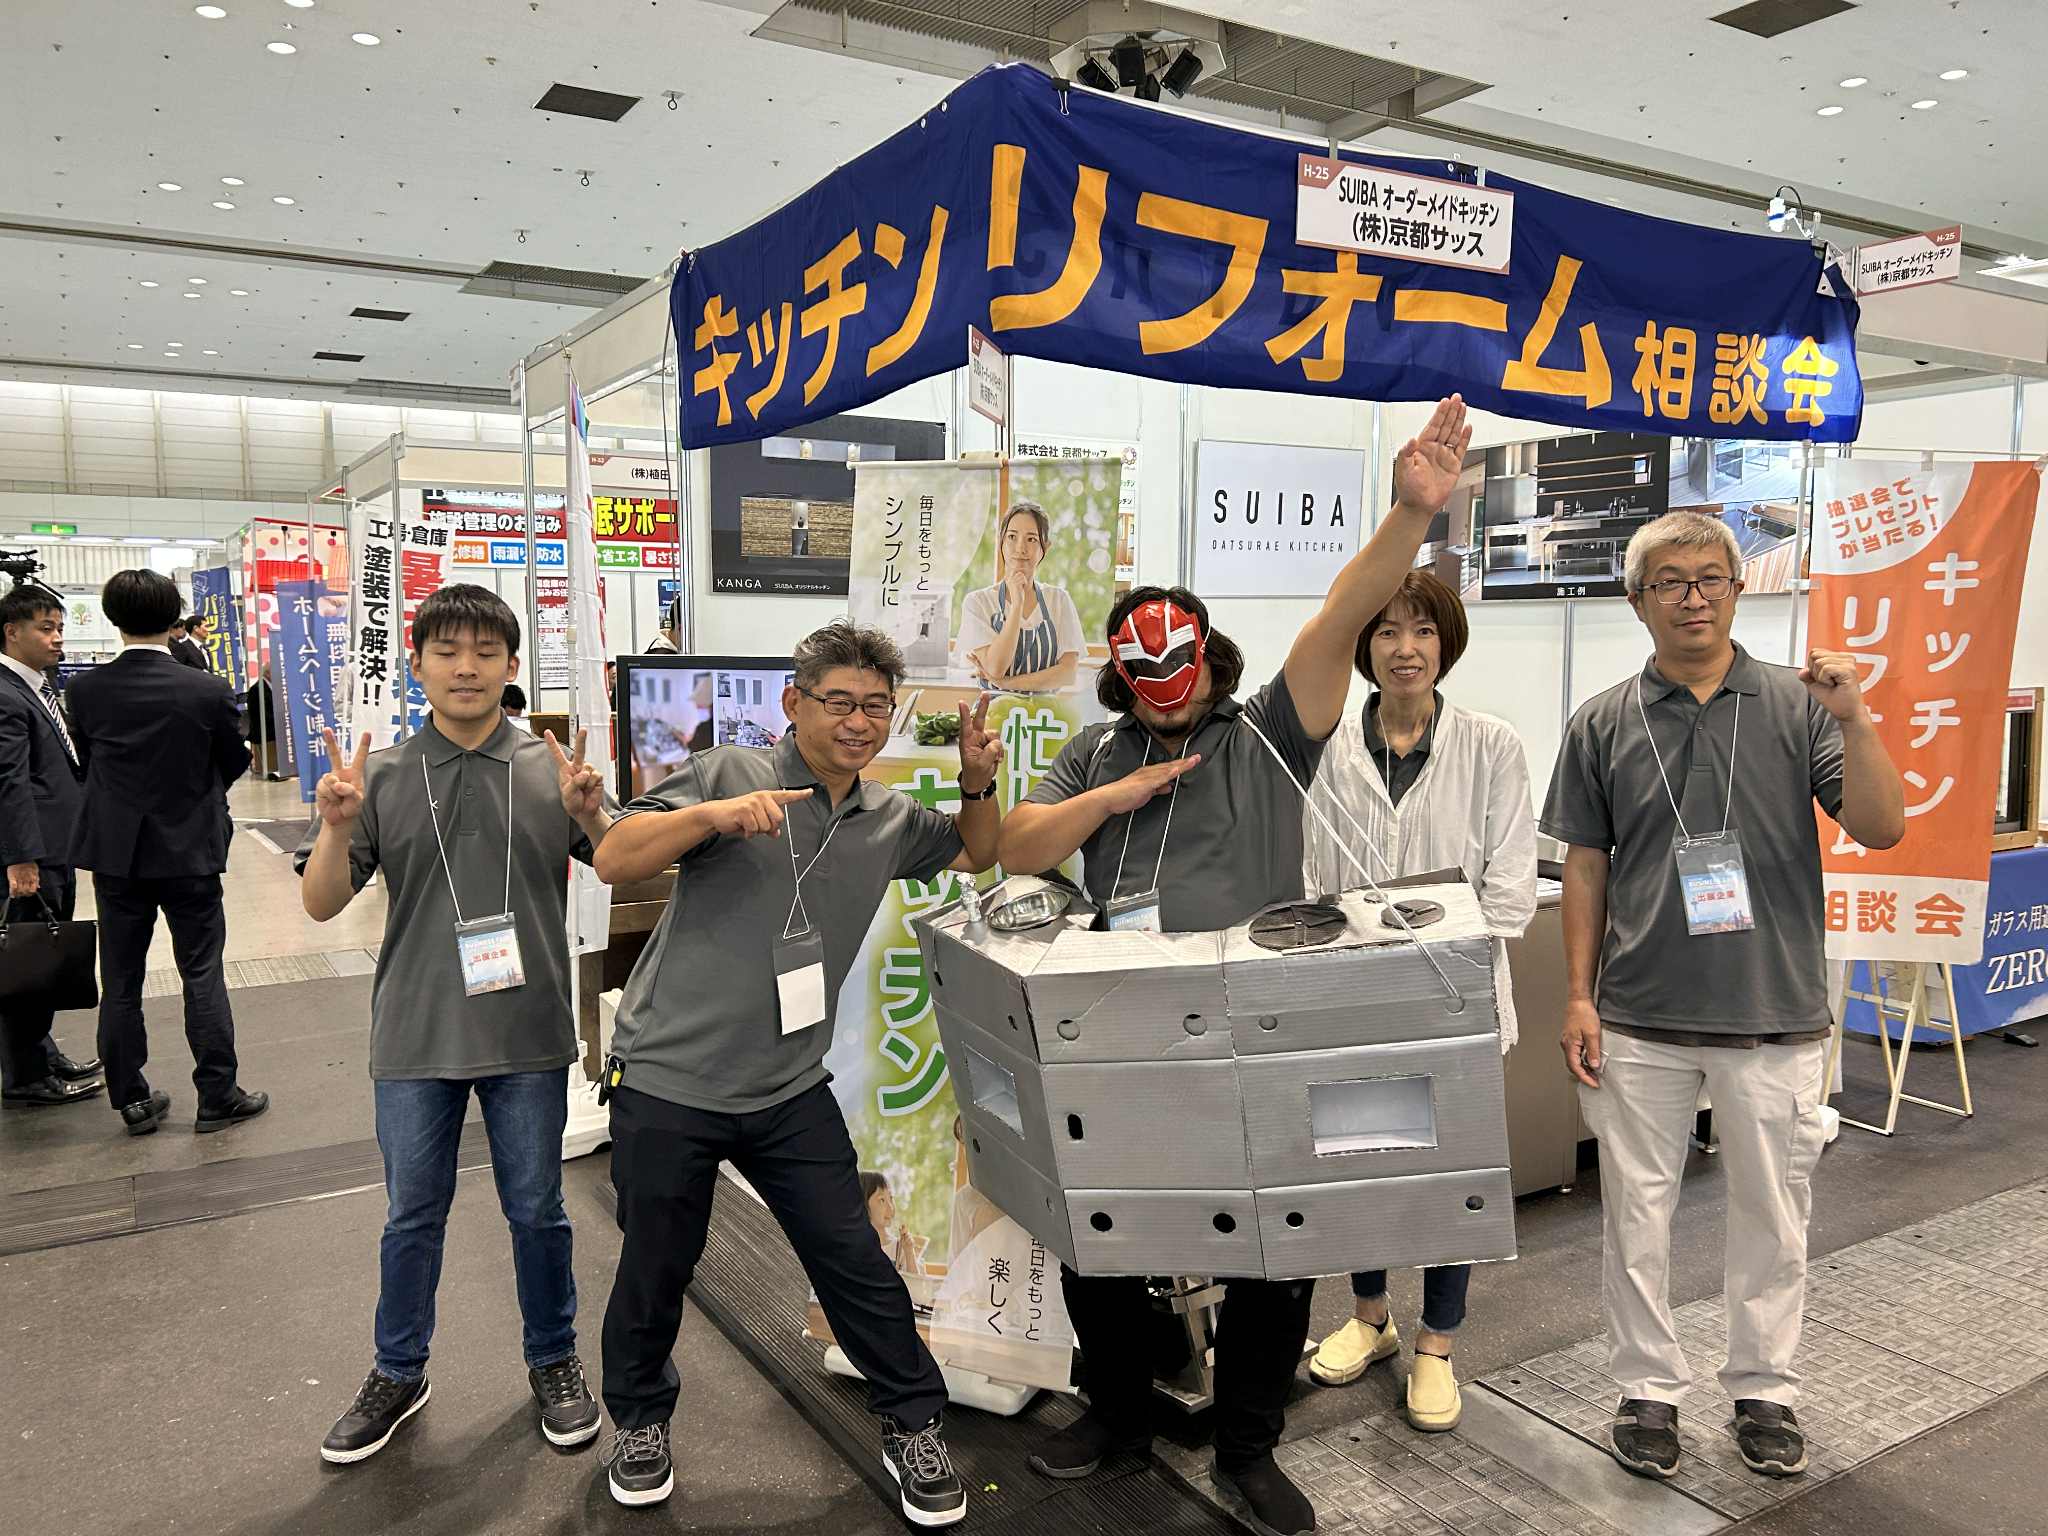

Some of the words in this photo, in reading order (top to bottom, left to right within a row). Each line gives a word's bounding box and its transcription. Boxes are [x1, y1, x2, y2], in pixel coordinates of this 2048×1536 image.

[1303, 164, 1330, 180] H-25
[1338, 176, 1379, 207] SUIBA
[1382, 184, 1500, 228] オーダーメイドキッチン
[1352, 211, 1484, 257] (株)京都サッス
[1936, 232, 1956, 243] H-25
[1861, 261, 1882, 275] SUIBA
[1884, 247, 1954, 271] オーダーメイドキッチン
[1877, 263, 1935, 286] (株)京都サッス
[694, 204, 949, 427] キッチン
[986, 144, 1612, 411] リフォーム
[1632, 320, 1840, 428] 相談会
[1017, 443, 1059, 458] 株式会社
[1213, 489, 1345, 527] SUIBA
[1825, 476, 1915, 519] 抽選会で
[1831, 493, 1939, 540] プレゼント
[881, 495, 904, 608] シンプルに
[916, 495, 935, 592] 毎日をもっと
[1289, 541, 1344, 553] KITCHEN
[1838, 513, 1939, 560] が当たる!
[717, 578, 763, 589] KANGA
[1556, 586, 1586, 597] 施工例
[1904, 552, 1980, 818] キッチン
[1985, 948, 2048, 995] ZER
[987, 1256, 1012, 1336] 楽しく
